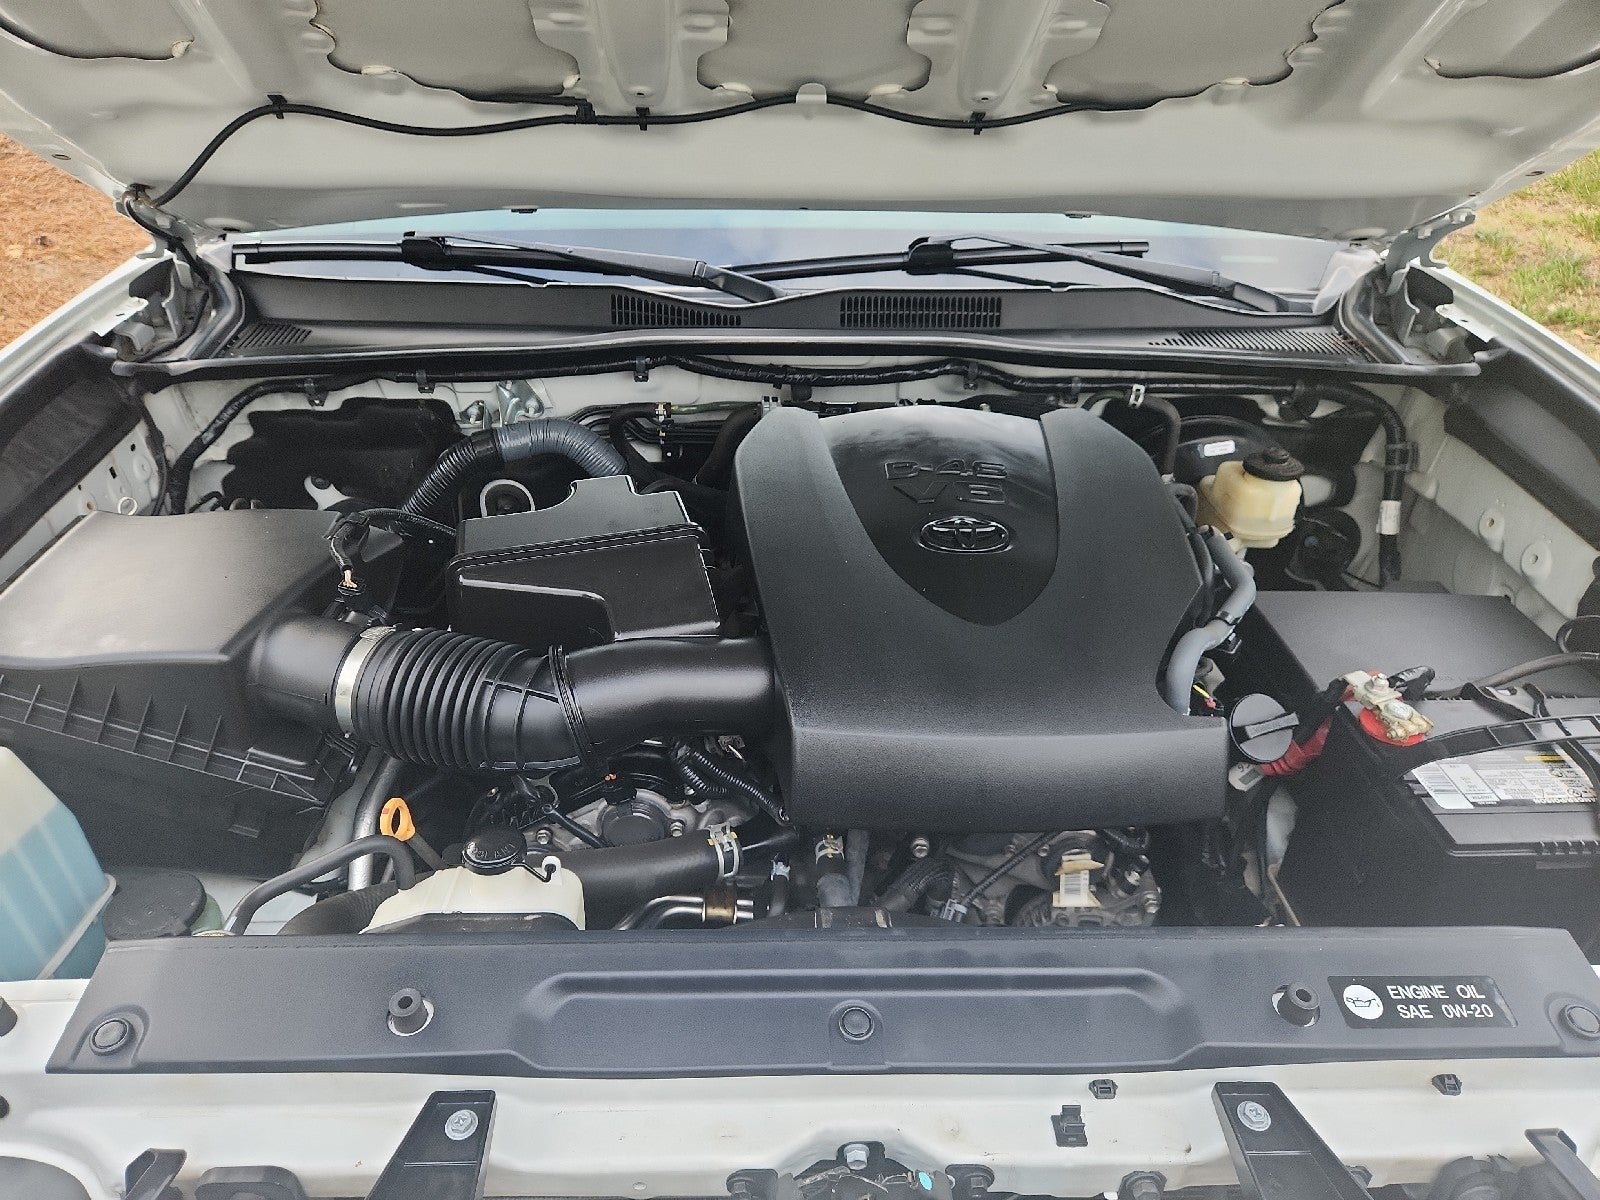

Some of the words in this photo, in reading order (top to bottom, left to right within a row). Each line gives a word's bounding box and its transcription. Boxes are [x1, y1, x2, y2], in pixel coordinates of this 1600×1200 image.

[892, 480, 1008, 505] V6
[1386, 984, 1450, 999] ENGINE
[1455, 984, 1486, 999] OIL
[1396, 1004, 1434, 1019] SAE
[1441, 1003, 1494, 1018] 0W-20
